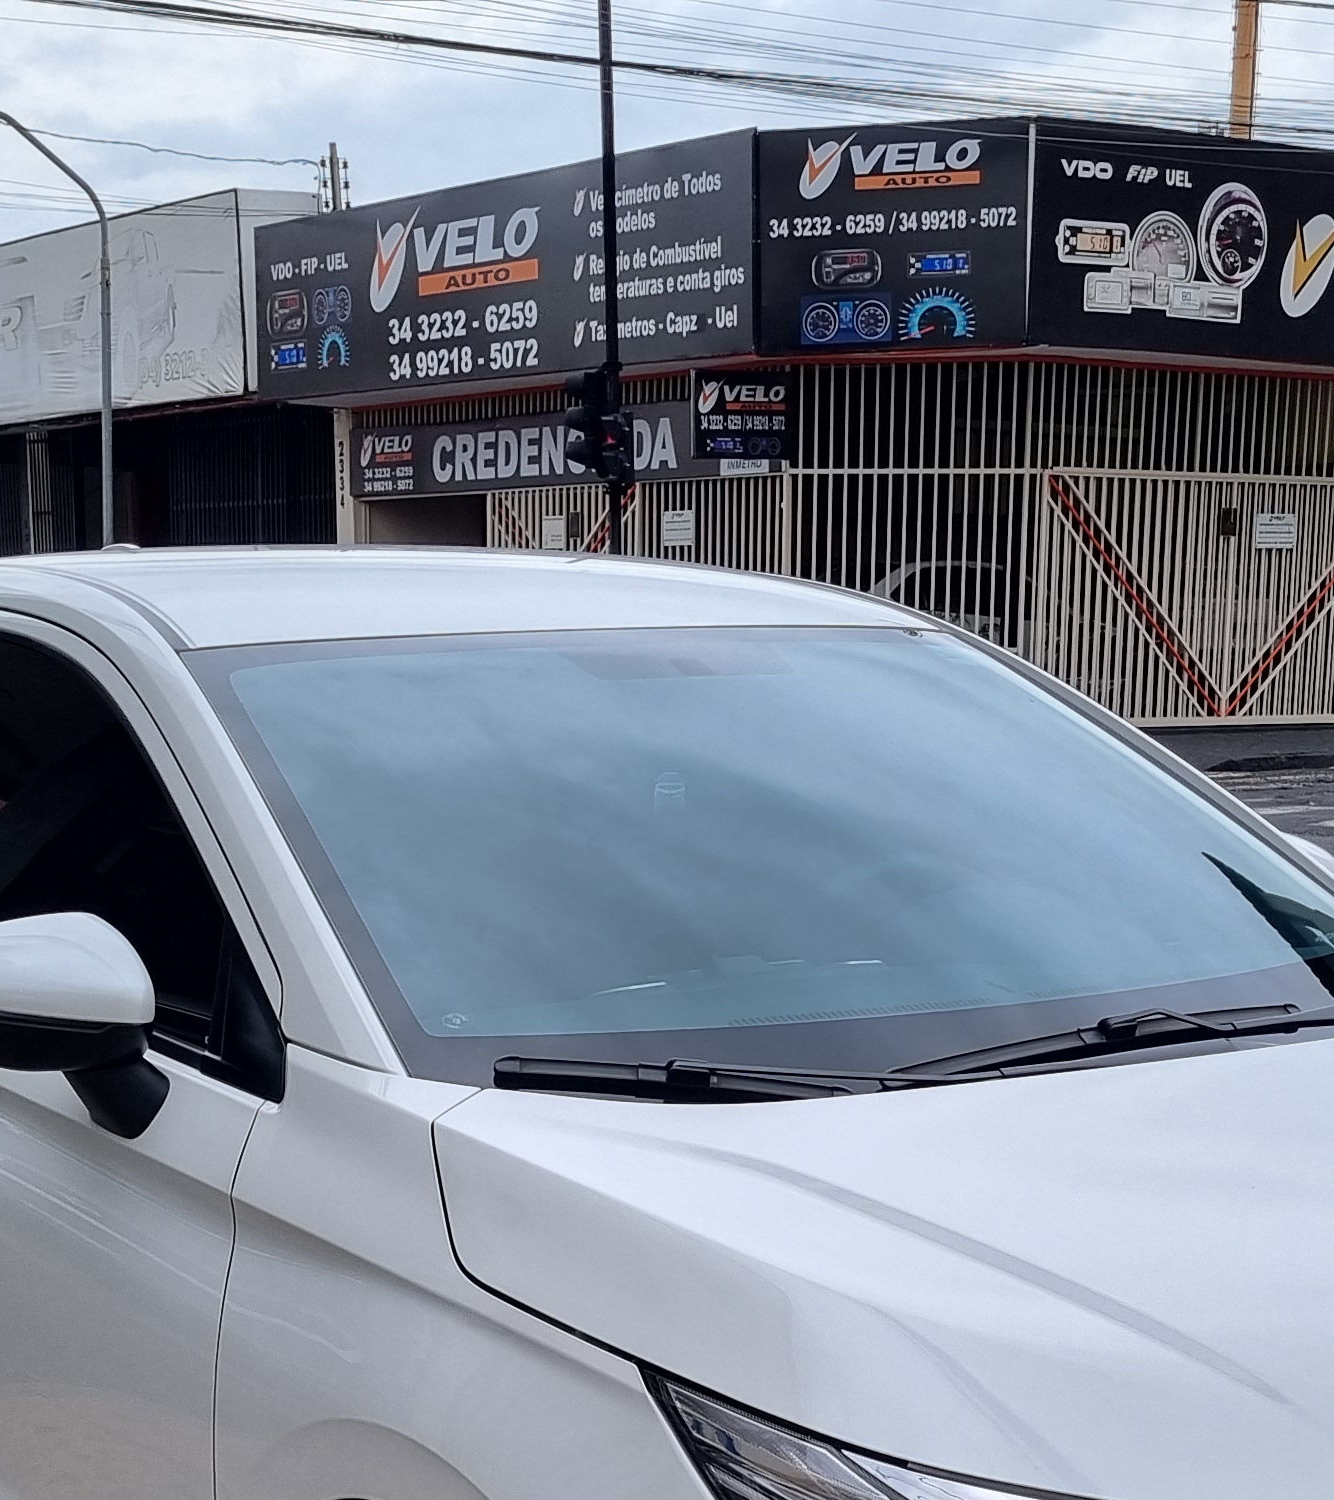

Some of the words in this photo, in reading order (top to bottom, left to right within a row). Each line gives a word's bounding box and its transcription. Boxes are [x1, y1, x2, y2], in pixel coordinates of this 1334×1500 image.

[849, 138, 983, 176] VELO
[883, 175, 952, 187] AUTO
[1061, 158, 1114, 180] VDO
[1165, 168, 1193, 188] UEL
[589, 181, 661, 212] Vecímetro
[663, 177, 679, 200] de
[682, 170, 722, 197] Todos
[589, 220, 604, 238] os
[769, 218, 790, 239] 34
[793, 215, 833, 237] 3232
[845, 213, 885, 235] 6259
[898, 211, 919, 233] 34
[921, 209, 968, 231] 99218
[979, 206, 1018, 228] 5072
[413, 206, 542, 273] VELO
[632, 247, 647, 271] de
[649, 235, 722, 268] Combustível
[270, 261, 293, 281] VDO
[301, 257, 319, 276] FIP
[326, 251, 349, 272] UEL
[444, 267, 511, 290] AUTO
[666, 277, 675, 293] e
[677, 268, 711, 293] conta
[713, 263, 746, 294] giros
[388, 316, 413, 345] 34
[417, 309, 467, 342] 3232
[485, 299, 538, 333] 6259
[715, 304, 739, 329] Uel
[389, 353, 412, 381] 34
[416, 346, 473, 378] 99218
[489, 338, 539, 370] 5072
[723, 385, 786, 402] VELO
[374, 434, 412, 454] VELO
[432, 417, 678, 484] CREDENDA
